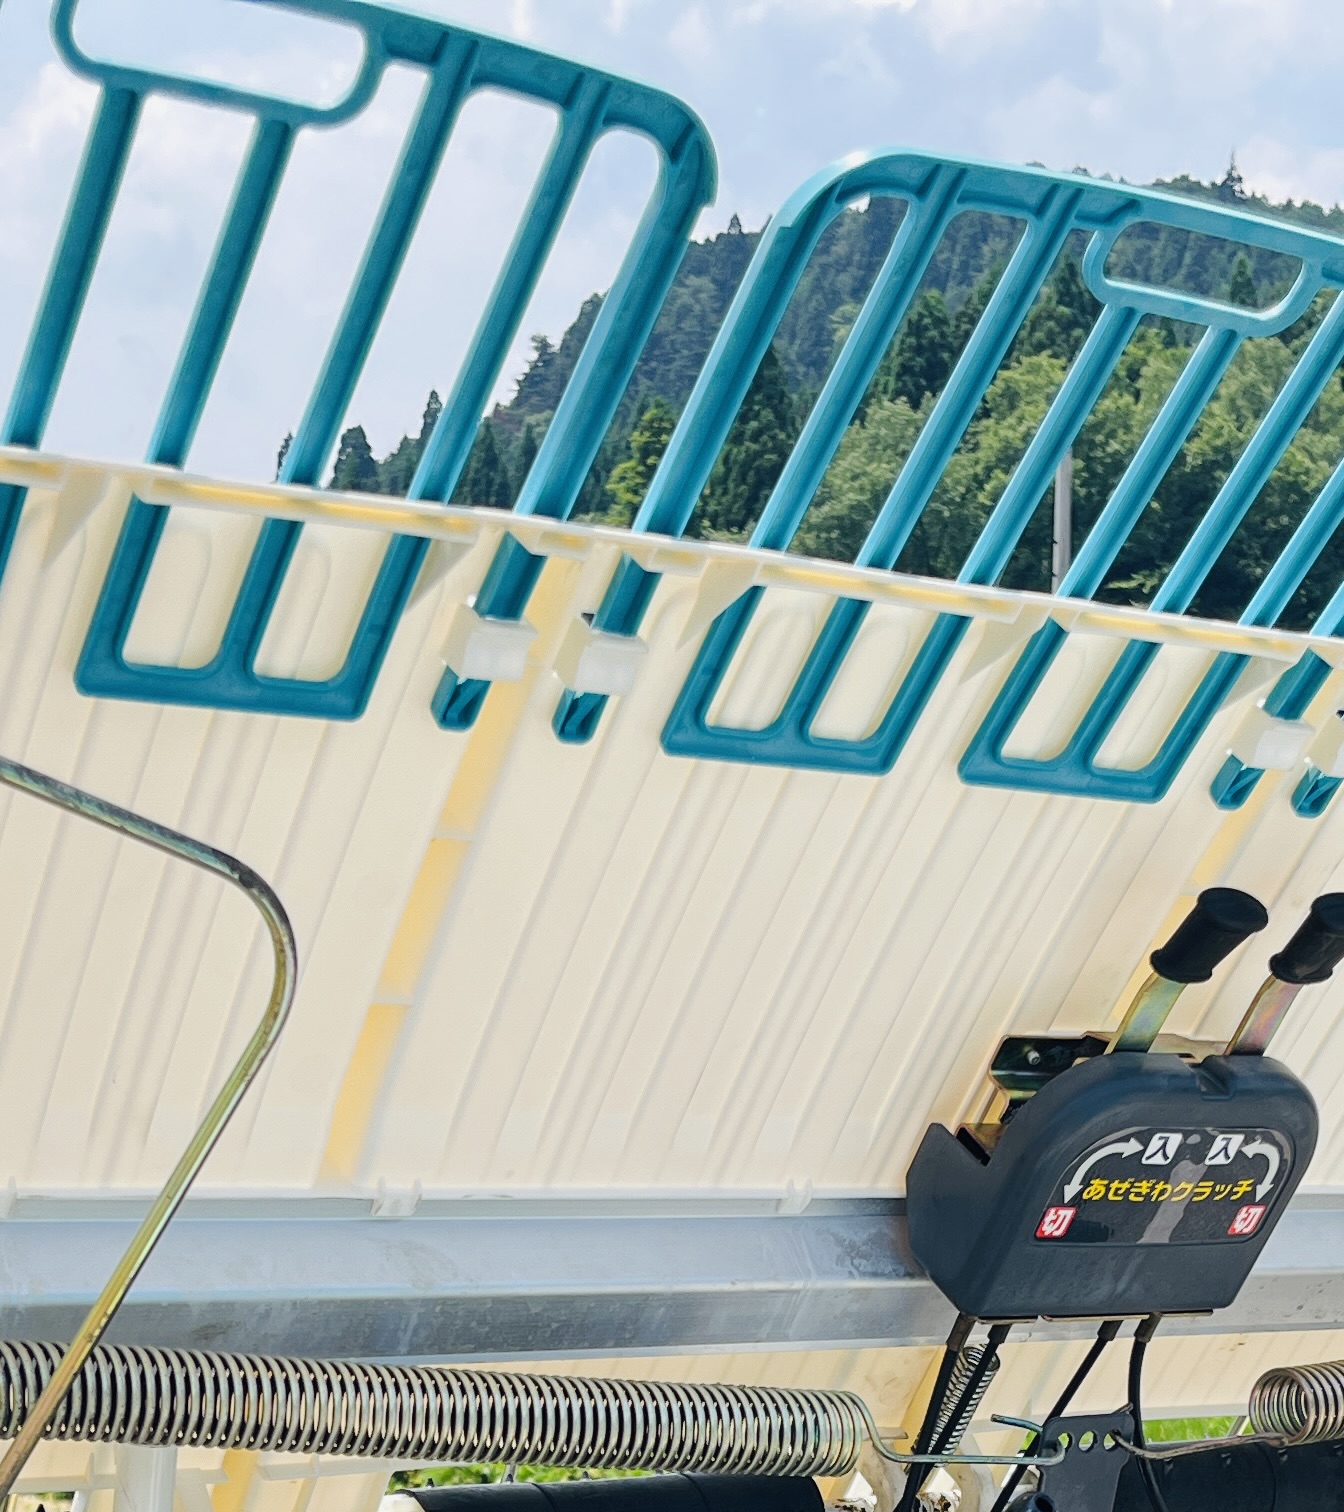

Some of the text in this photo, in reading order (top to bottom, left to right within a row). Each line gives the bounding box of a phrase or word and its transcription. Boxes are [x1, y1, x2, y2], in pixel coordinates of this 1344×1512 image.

[1144, 1134, 1178, 1164] 入
[1207, 1135, 1241, 1164] 入
[1082, 1178, 1256, 1202] あぜぎわクラッチ
[1040, 1207, 1074, 1237] 切
[1230, 1206, 1265, 1235] 切
